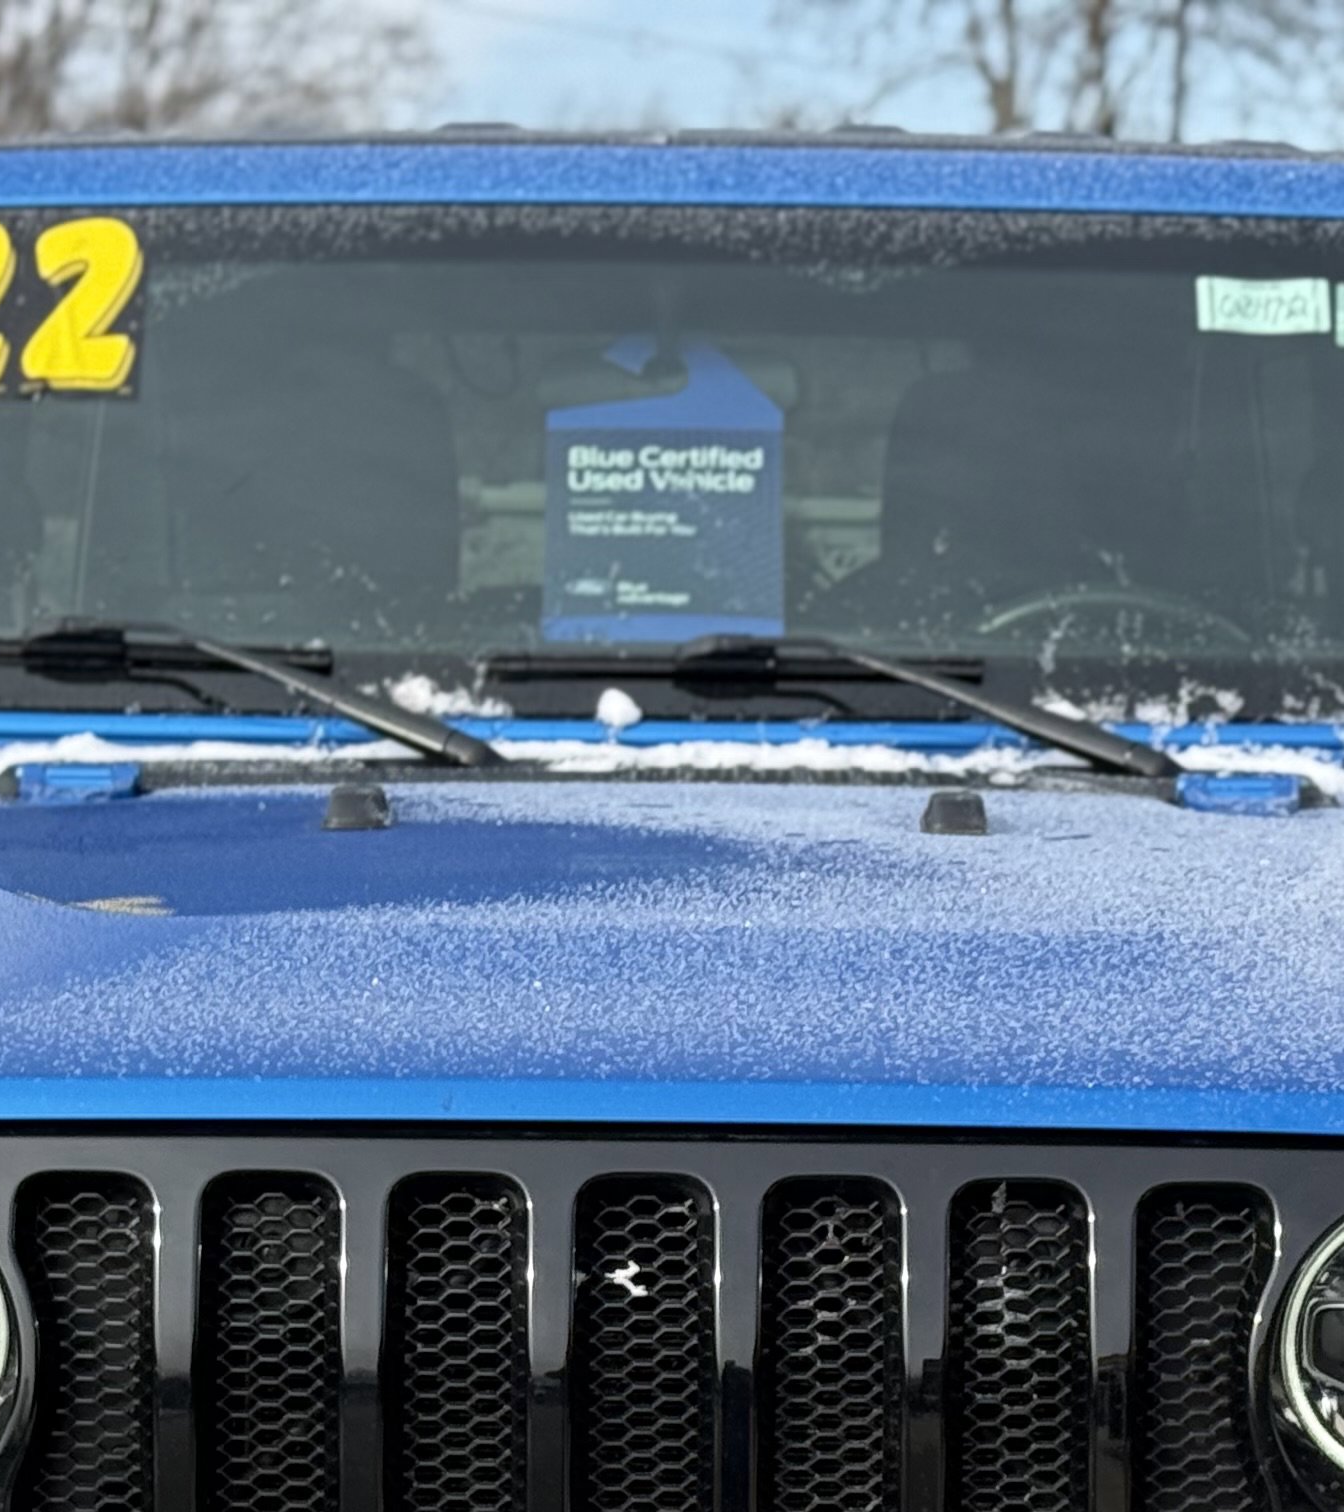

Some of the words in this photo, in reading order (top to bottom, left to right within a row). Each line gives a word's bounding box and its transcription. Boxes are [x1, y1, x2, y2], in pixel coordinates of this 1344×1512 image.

[568, 446, 633, 468] Blue
[638, 446, 764, 470] Certified
[568, 470, 644, 492] Used
[650, 471, 755, 492] Vehicle
